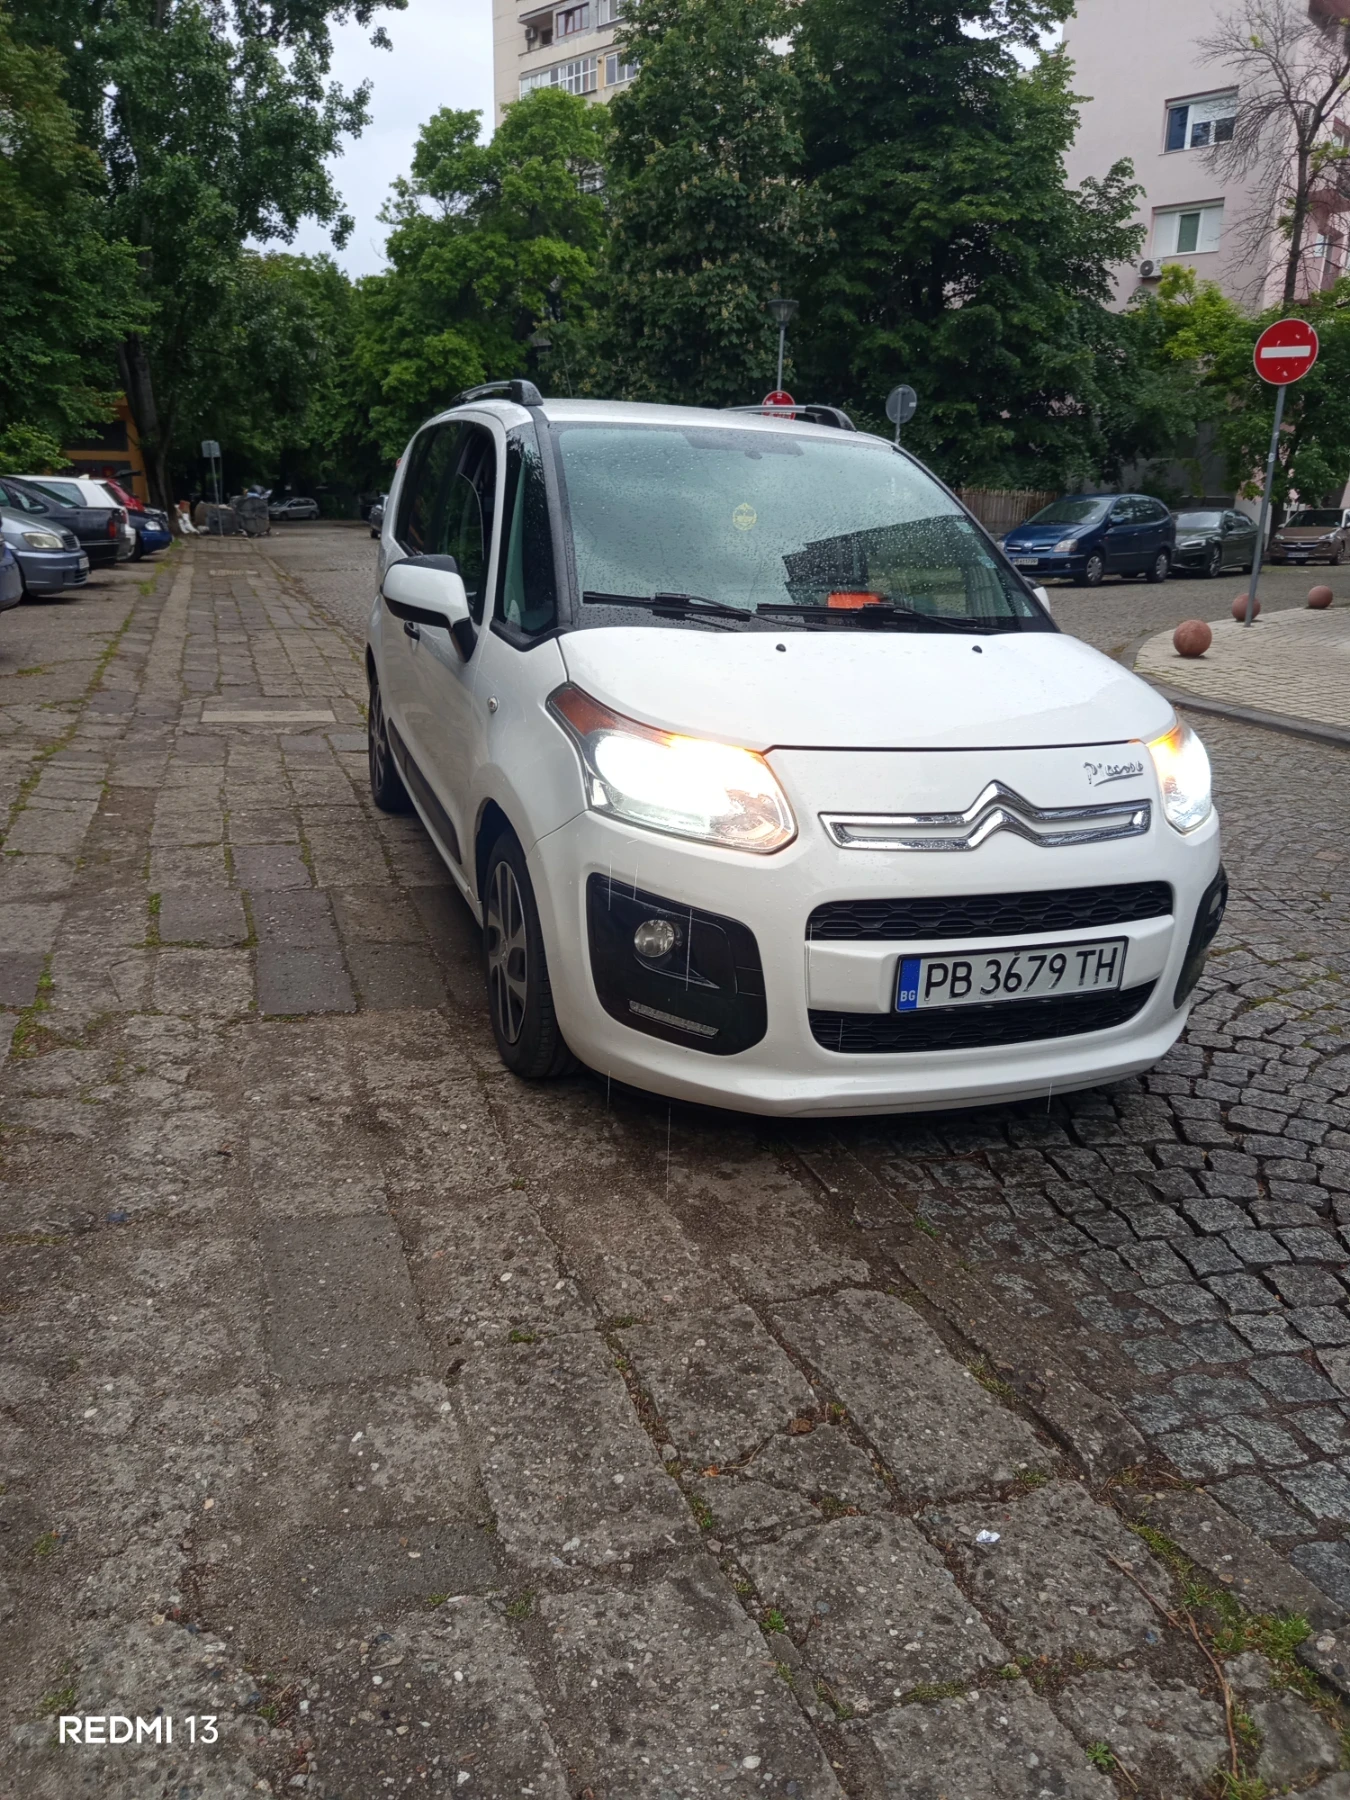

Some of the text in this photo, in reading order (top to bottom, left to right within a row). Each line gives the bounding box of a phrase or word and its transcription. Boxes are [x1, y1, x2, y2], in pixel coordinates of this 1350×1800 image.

[924, 947, 1118, 1001] PB 3679 TH
[900, 990, 916, 1002] BG
